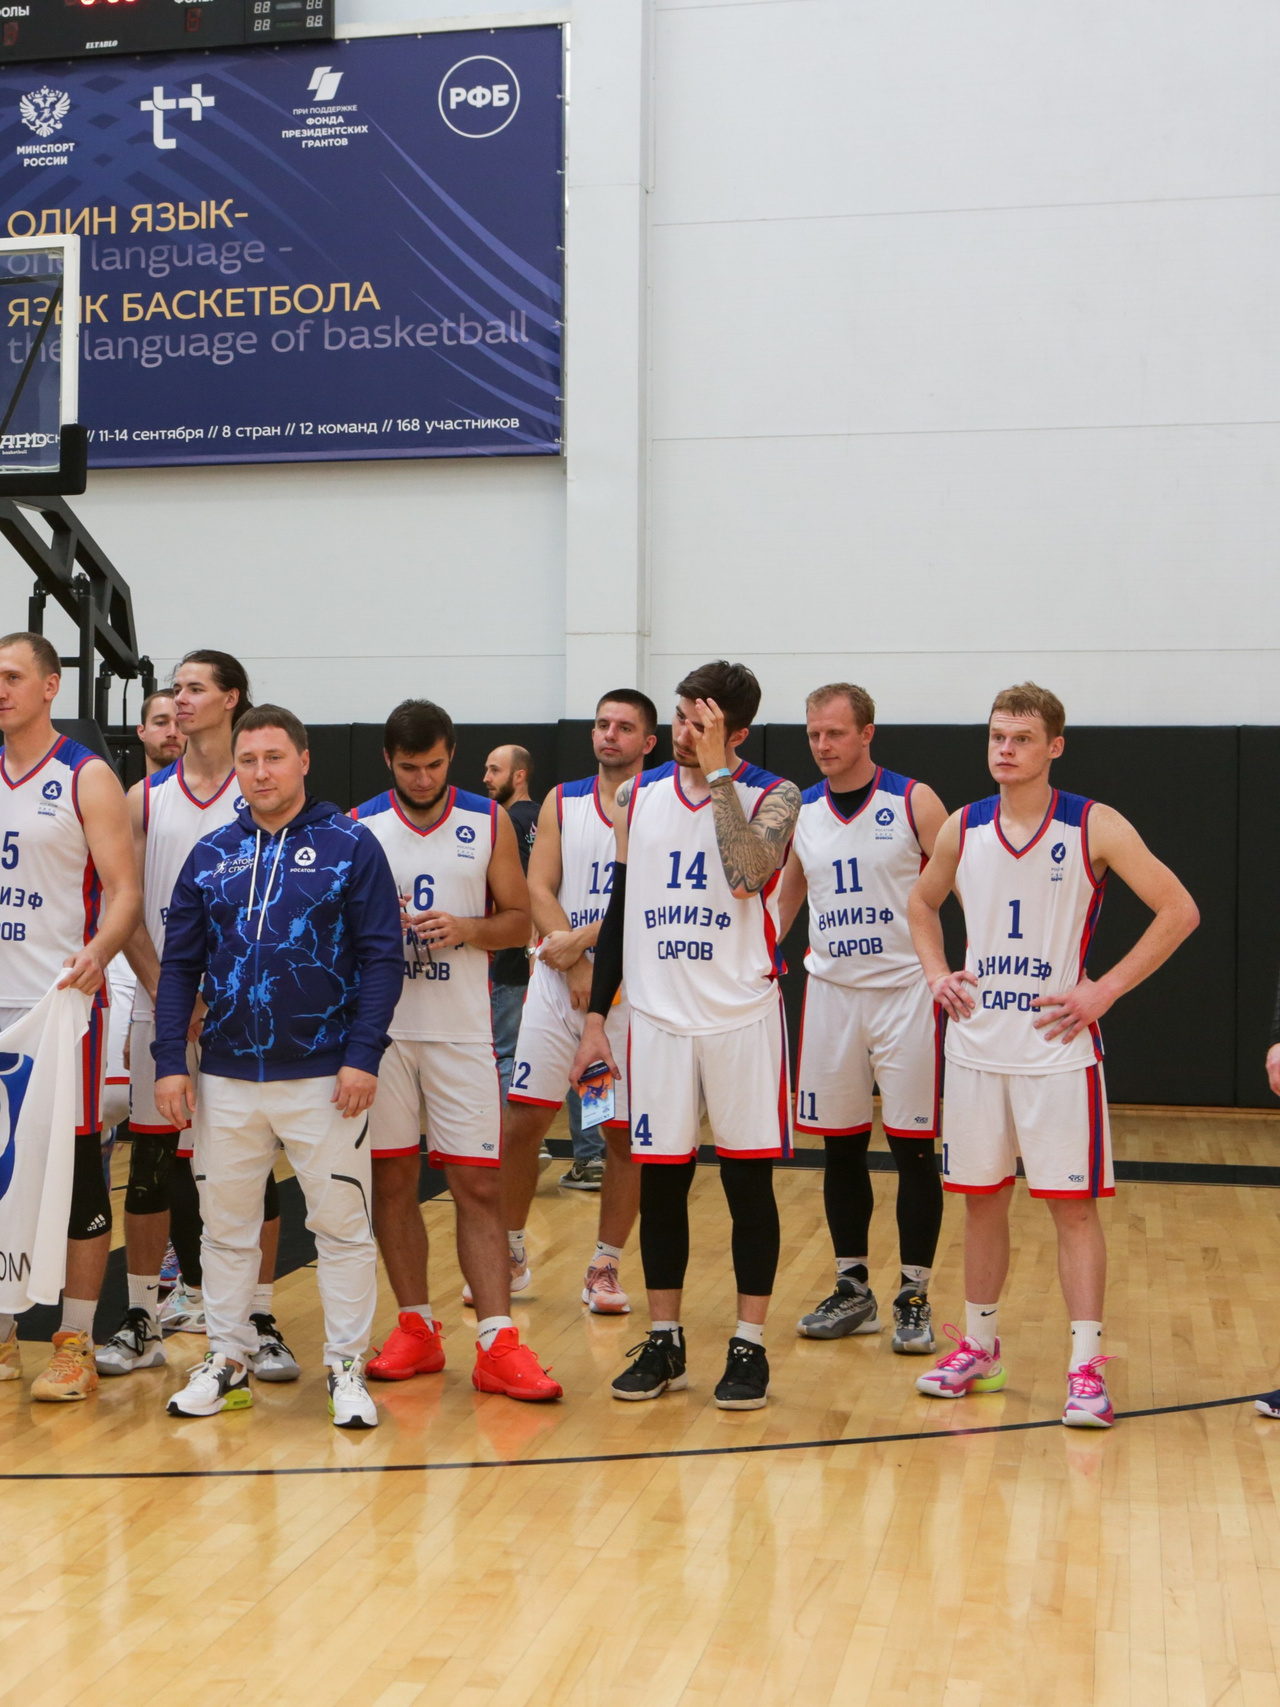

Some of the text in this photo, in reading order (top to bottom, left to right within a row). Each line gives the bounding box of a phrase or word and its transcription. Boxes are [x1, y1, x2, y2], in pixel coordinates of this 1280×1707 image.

[85, 40, 118, 49] ELTABLO
[309, 105, 358, 114] ПОДДЕРЖКЕ
[449, 84, 510, 110] РФБ
[282, 125, 368, 138] ПРЕЗИДЕНТСКИХ
[306, 116, 344, 125] ФОНДА
[16, 143, 75, 155] МИНСПОРТ
[302, 138, 348, 148] ГРАНТОВ
[23, 156, 68, 167] РОССИИ
[7, 206, 117, 238] ОДИН
[91, 239, 265, 278] language
[123, 281, 381, 322] БАСКЕТБОЛА
[84, 330, 258, 368] language
[271, 319, 314, 352] of
[324, 310, 529, 350] basketball
[99, 429, 128, 442] 11-14
[132, 426, 204, 444] сентября
[222, 425, 231, 437] 8
[235, 424, 281, 441] стран
[299, 422, 313, 435] 12
[318, 422, 378, 435] команд
[396, 419, 420, 432] 168
[424, 418, 519, 434] участников
[589, 861, 614, 895] 12
[666, 851, 708, 889] 14
[832, 857, 863, 894] 11
[413, 874, 435, 911] 6
[644, 905, 731, 930] ВНИИЭФ
[819, 907, 894, 931] ВНИИЭФ
[1007, 899, 1023, 939] 1
[658, 940, 713, 961] САРОВ
[828, 937, 883, 958] САРОВ
[403, 960, 450, 981] АРОВ
[799, 1090, 819, 1121] 11
